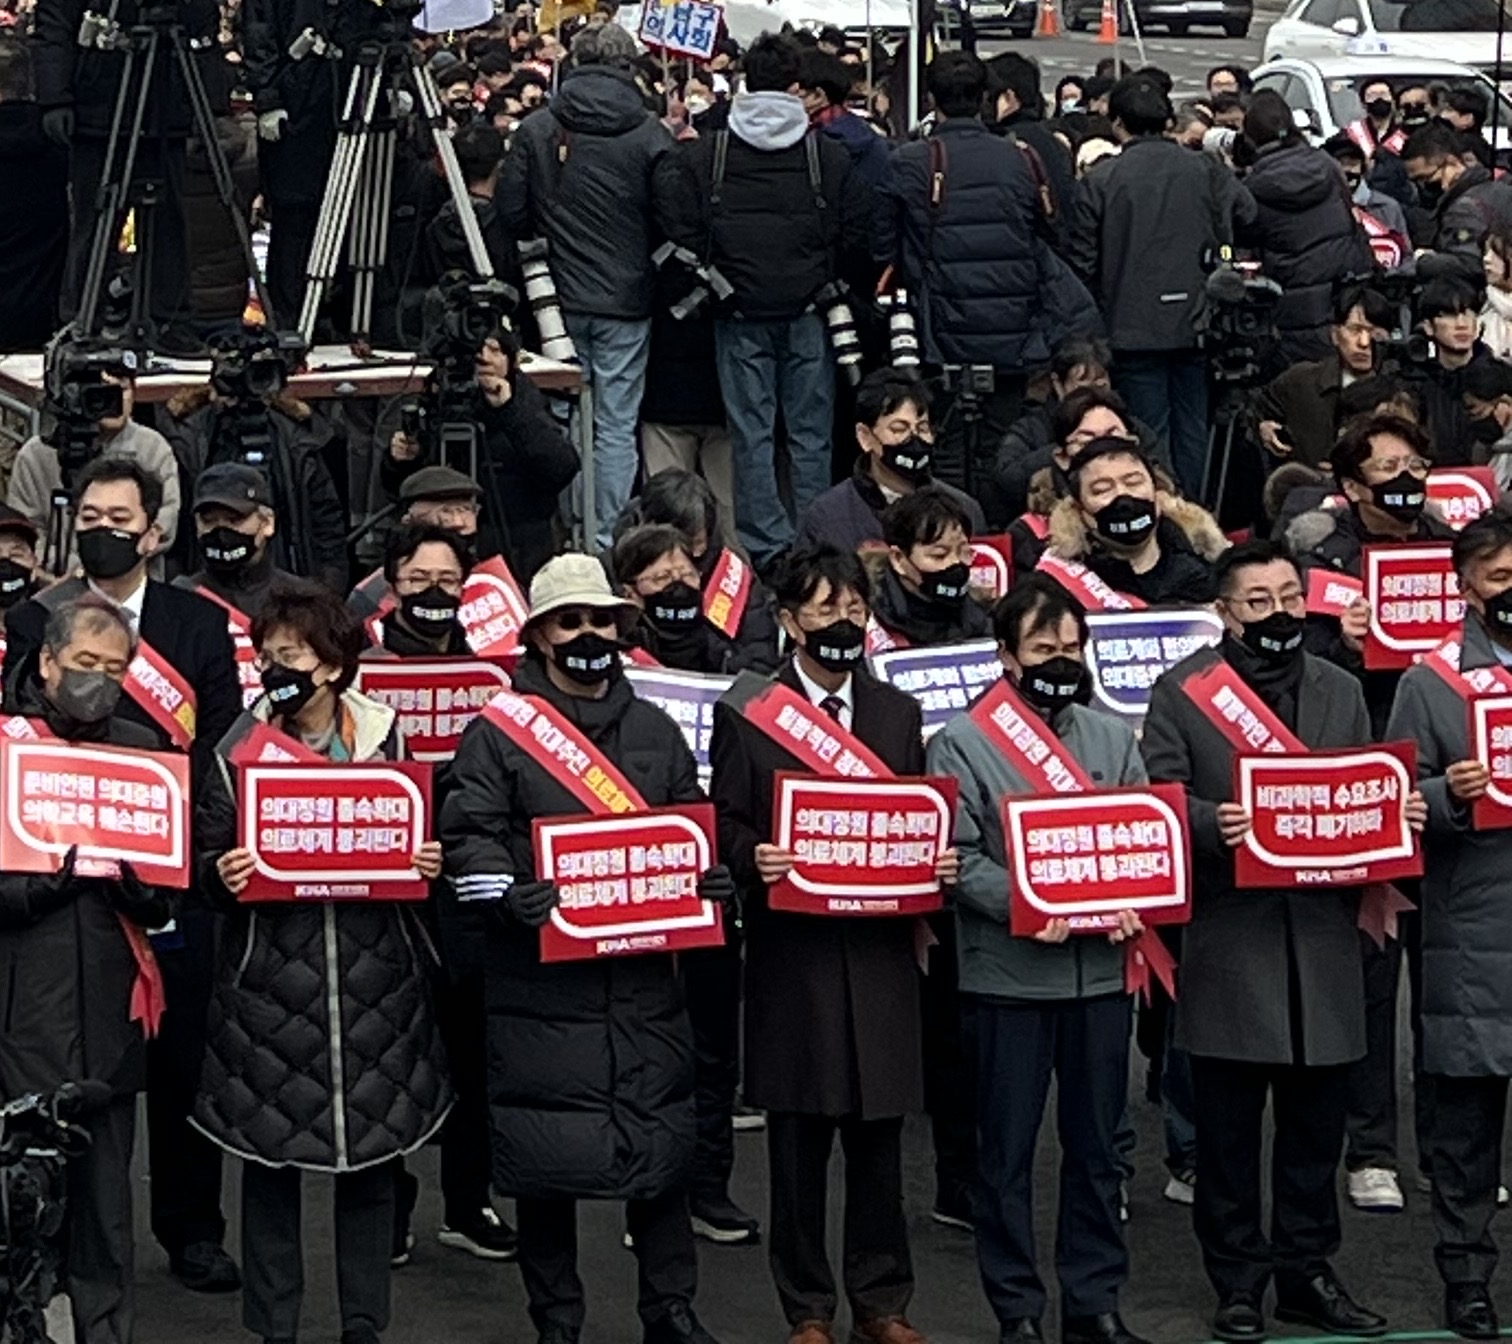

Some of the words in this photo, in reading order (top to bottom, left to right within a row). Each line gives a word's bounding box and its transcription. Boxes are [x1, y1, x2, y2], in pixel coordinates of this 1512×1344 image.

[98, 778, 168, 810] 의대증원
[1334, 775, 1398, 809] 수요조사
[260, 797, 334, 823] 의대정원
[337, 795, 409, 824] 졸속확대
[793, 807, 869, 837] 의대정원
[870, 810, 938, 839] 졸속확대
[260, 826, 334, 853] 의료체계
[337, 826, 409, 853] 붕괴된다
[792, 838, 867, 867] 의료체계
[869, 840, 936, 869] 붕괴된다
[1027, 825, 1094, 854] 의대정원
[1096, 820, 1168, 852] 졸속확대
[557, 845, 626, 878] 의대정원
[629, 841, 696, 873] 졸속확대
[1029, 854, 1098, 885] 의료체계
[1099, 849, 1170, 882] 붕괴된다
[558, 878, 628, 910] 의료체계
[630, 872, 697, 905] 붕괴된다
